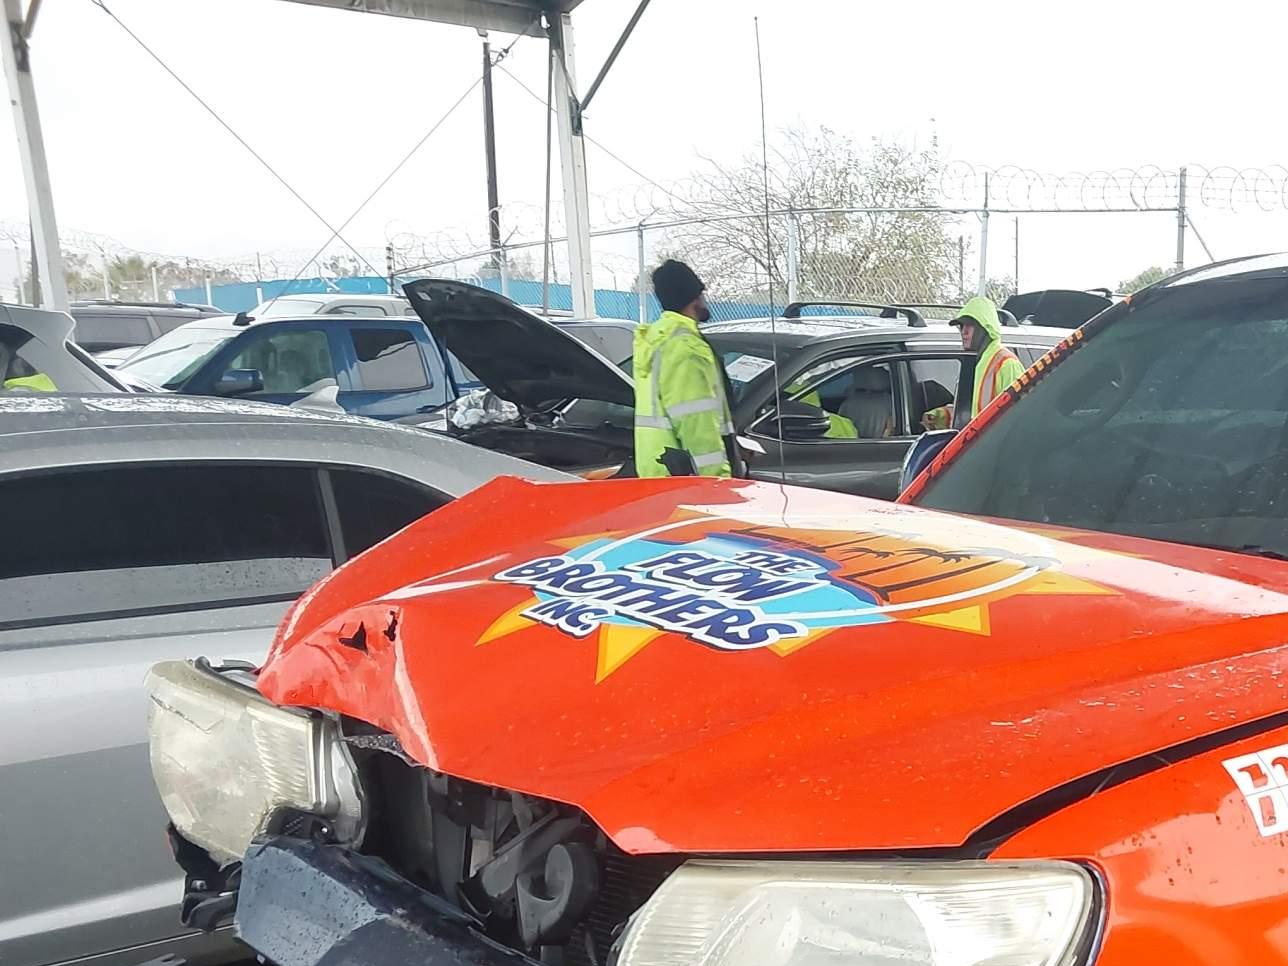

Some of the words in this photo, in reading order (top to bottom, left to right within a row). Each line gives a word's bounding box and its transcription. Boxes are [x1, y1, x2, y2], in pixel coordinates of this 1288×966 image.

[634, 552, 820, 602] FLOW
[734, 551, 819, 575] THE
[504, 558, 800, 646] BROTHERS
